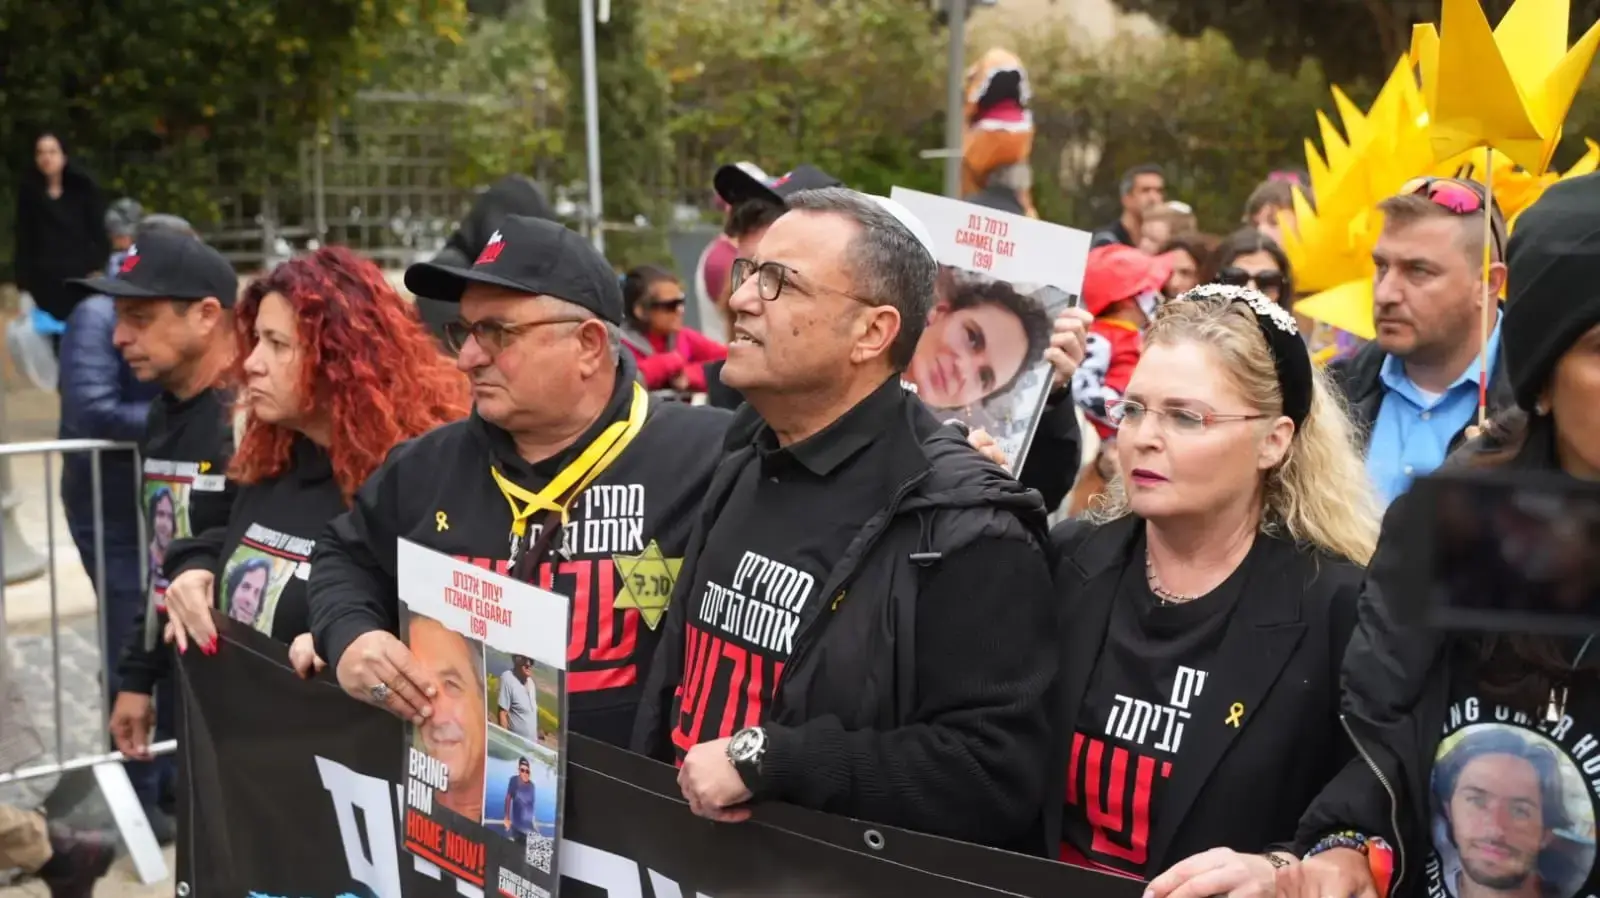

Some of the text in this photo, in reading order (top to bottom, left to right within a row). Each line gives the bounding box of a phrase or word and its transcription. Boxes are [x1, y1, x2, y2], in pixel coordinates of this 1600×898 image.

[955, 229, 1016, 257] CARMEL GAT
[972, 250, 993, 271] (39)
[583, 517, 645, 553] אותם
[481, 580, 503, 603] יצחק
[732, 551, 815, 614] מחזירים
[444, 586, 513, 628] ITZHAK ELGARAT
[699, 580, 746, 637] הביתה
[742, 599, 801, 656] אותם
[408, 747, 448, 792] BRING
[407, 776, 433, 815] HIM
[406, 808, 443, 853] HOME
[445, 829, 485, 876] NOW!
